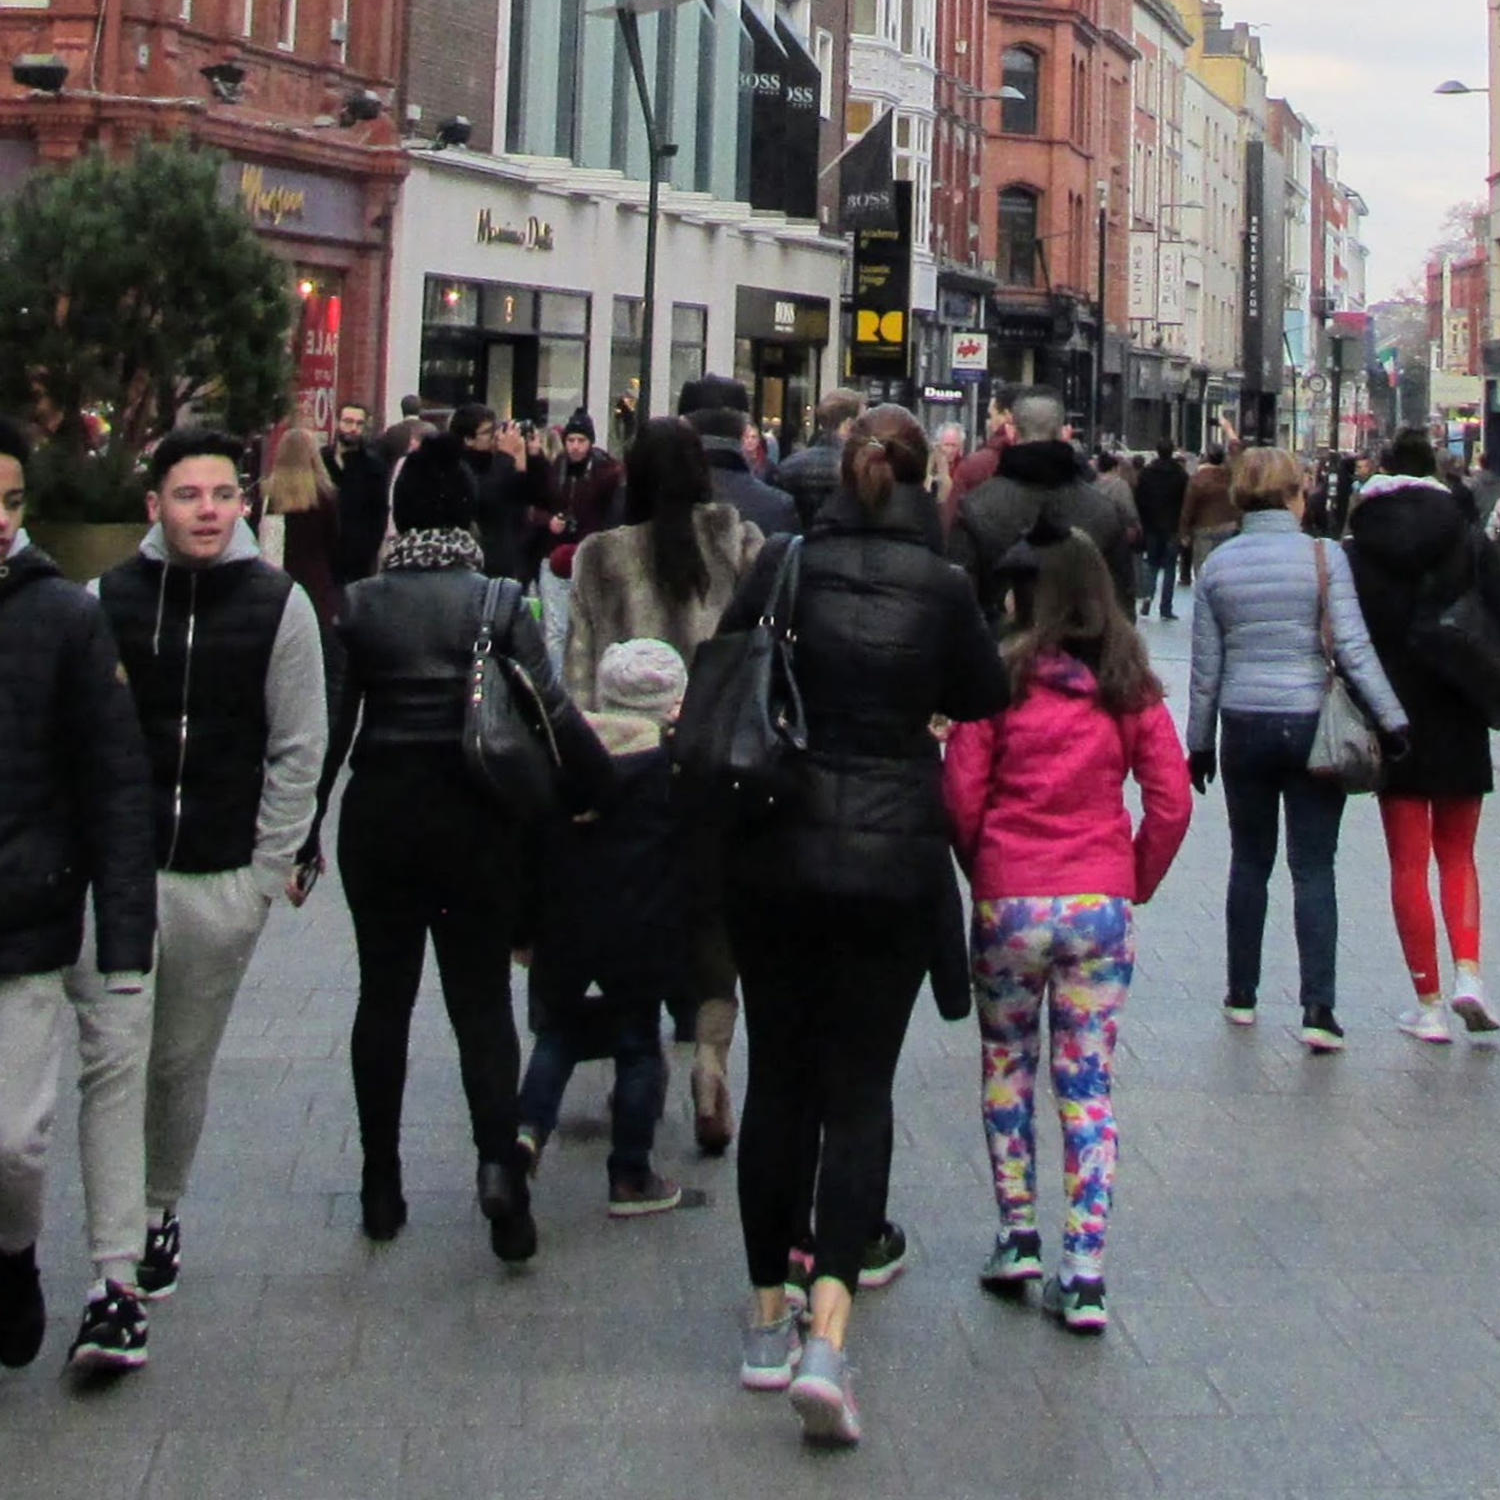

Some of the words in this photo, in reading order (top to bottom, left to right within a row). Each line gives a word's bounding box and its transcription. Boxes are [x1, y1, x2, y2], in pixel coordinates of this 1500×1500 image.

[847, 192, 890, 209] BOSS
[1132, 246, 1143, 305] LINKS
[924, 387, 963, 399] Dune
